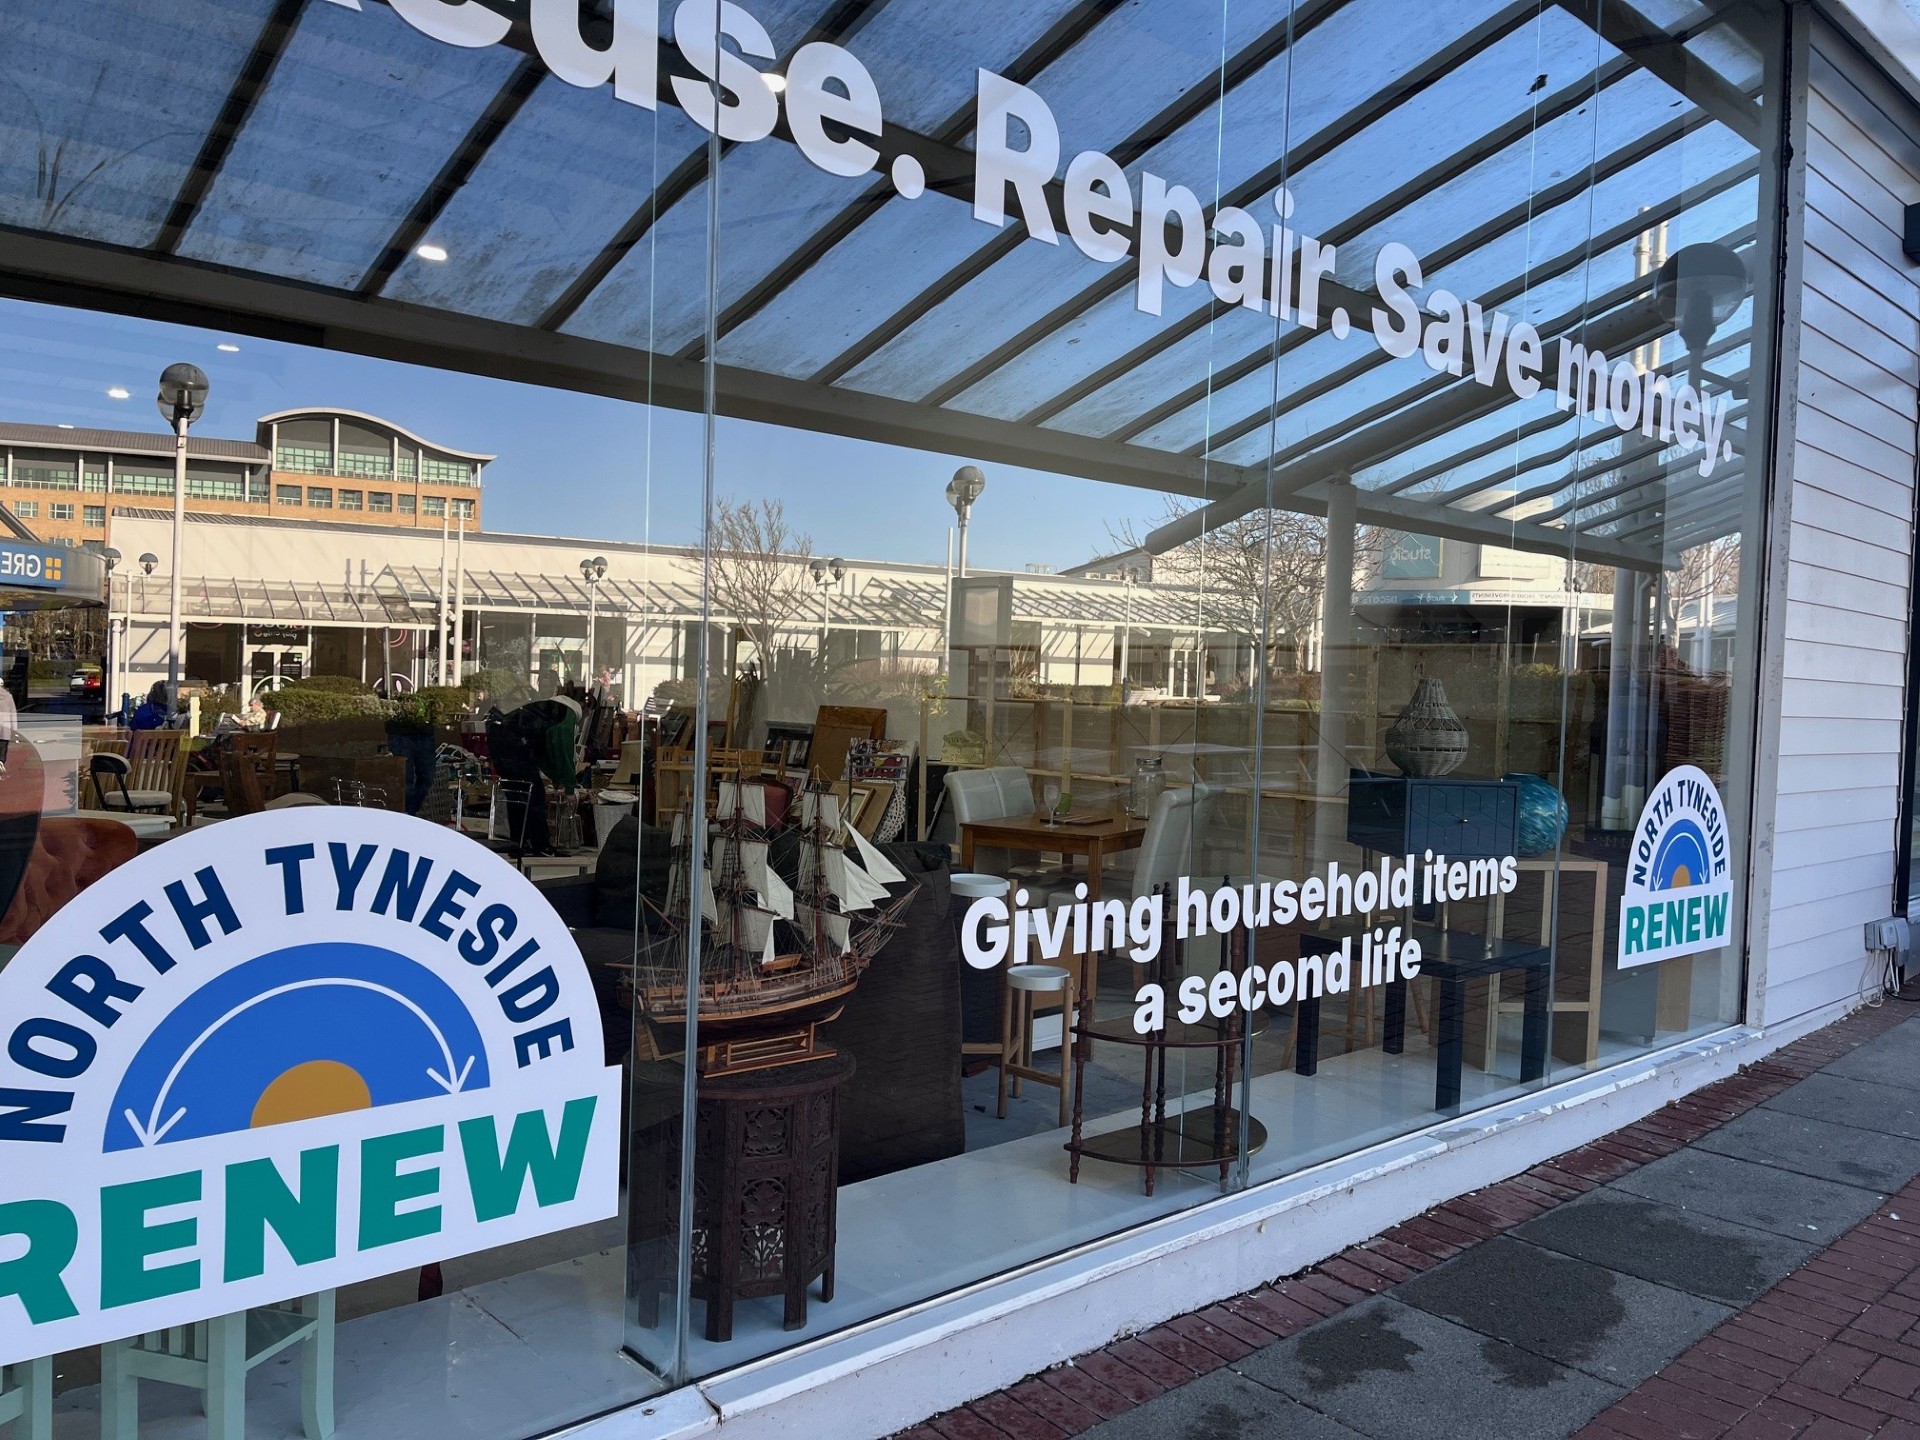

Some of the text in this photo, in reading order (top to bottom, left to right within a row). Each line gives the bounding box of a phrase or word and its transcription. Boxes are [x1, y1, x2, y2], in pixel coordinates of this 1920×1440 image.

[326, 0, 1732, 478] use. Repair. Save money.
[1633, 779, 1725, 886] NORTH TYNESIDE
[961, 848, 1517, 970] Giving household items
[1625, 892, 1728, 955] RENEW
[0, 842, 575, 1143] NORTH TYNESIDE
[1133, 926, 1422, 1034] a second life
